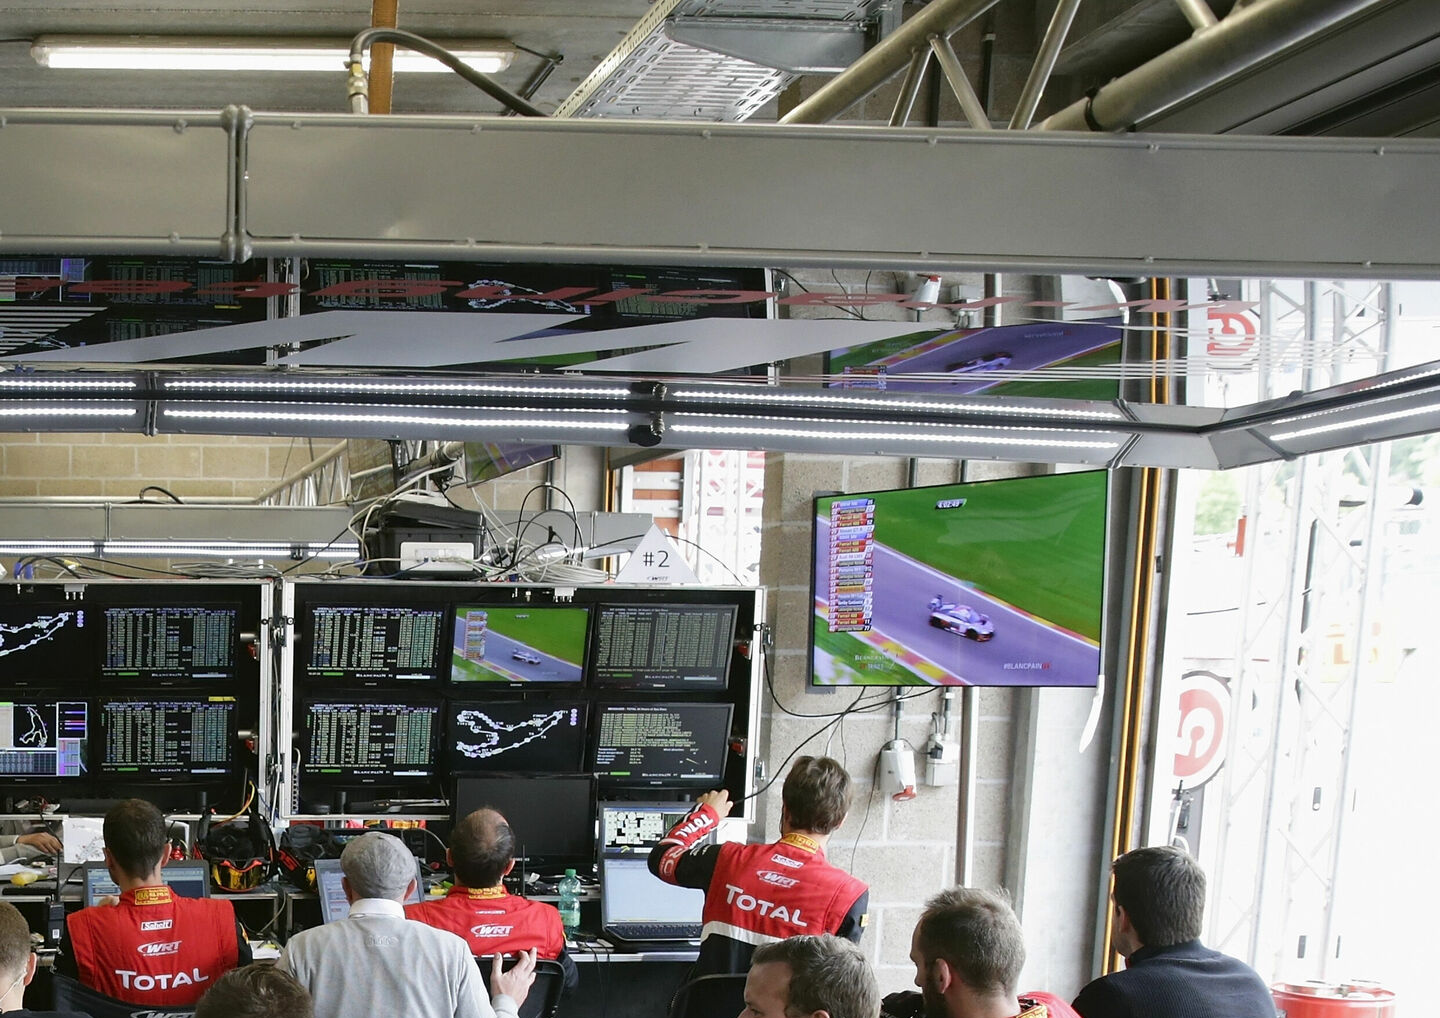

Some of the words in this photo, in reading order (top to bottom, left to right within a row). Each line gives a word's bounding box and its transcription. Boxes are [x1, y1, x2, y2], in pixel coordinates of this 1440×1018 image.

[643, 550, 670, 568] #2
[675, 813, 714, 838] TOTAL
[763, 872, 801, 887] WRT
[725, 883, 808, 927] TOTAL
[480, 925, 514, 936] WRT
[146, 941, 182, 954] WRT
[115, 967, 209, 991] TOTAL
